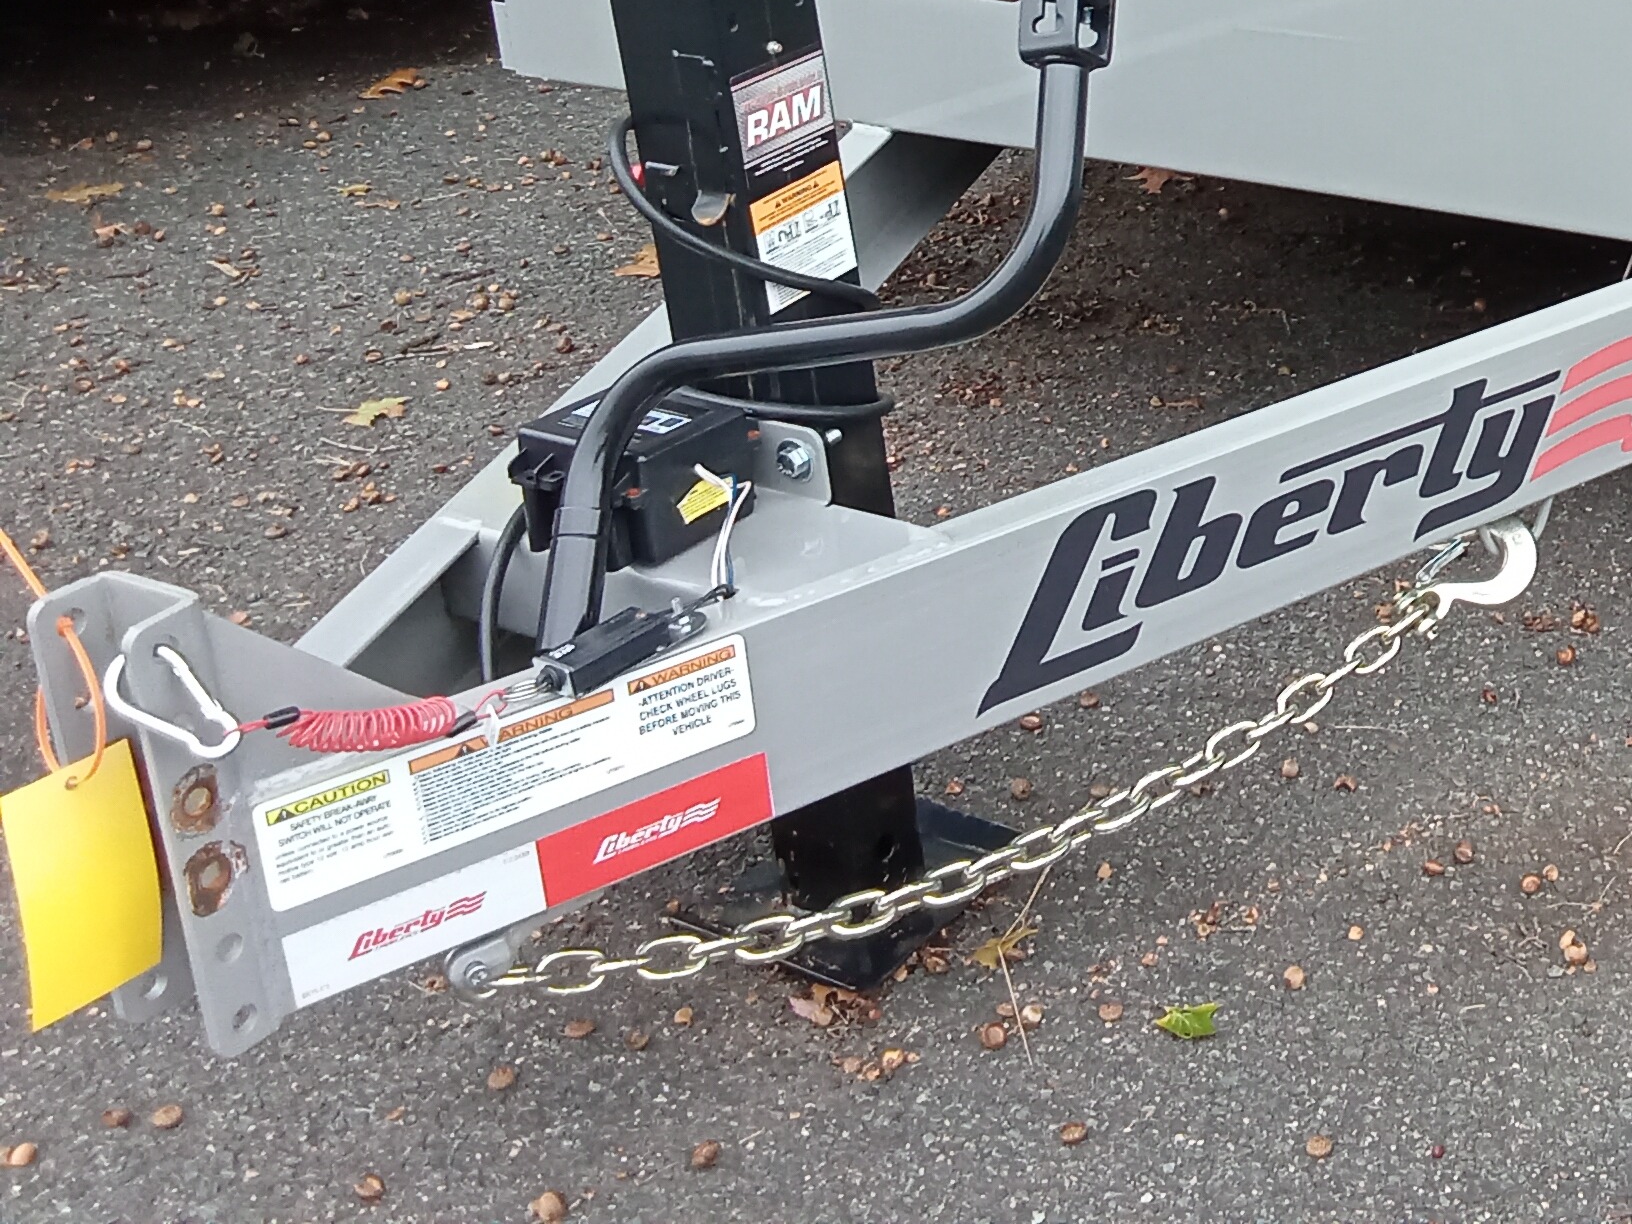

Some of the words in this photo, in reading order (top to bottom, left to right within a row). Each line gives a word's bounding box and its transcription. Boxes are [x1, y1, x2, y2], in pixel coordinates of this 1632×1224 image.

[747, 85, 822, 148] RAM
[976, 370, 1560, 718] Liberty
[652, 649, 732, 685] WARNING
[638, 714, 678, 736] BEFORE
[680, 699, 718, 720] MOVING
[721, 691, 742, 705] THIS
[640, 703, 673, 721] CHECK
[676, 689, 710, 708] WHEEL
[711, 679, 737, 695] LUGS
[672, 715, 712, 735] VEHICLE
[294, 772, 387, 814] CAUTION
[278, 829, 311, 847] SWITCH
[313, 823, 333, 837] WILL
[335, 815, 352, 827] NOT
[354, 800, 392, 820] OPERATE
[289, 813, 322, 831] SAFETY
[592, 811, 684, 865] Liberty
[347, 905, 446, 961] Liberty
